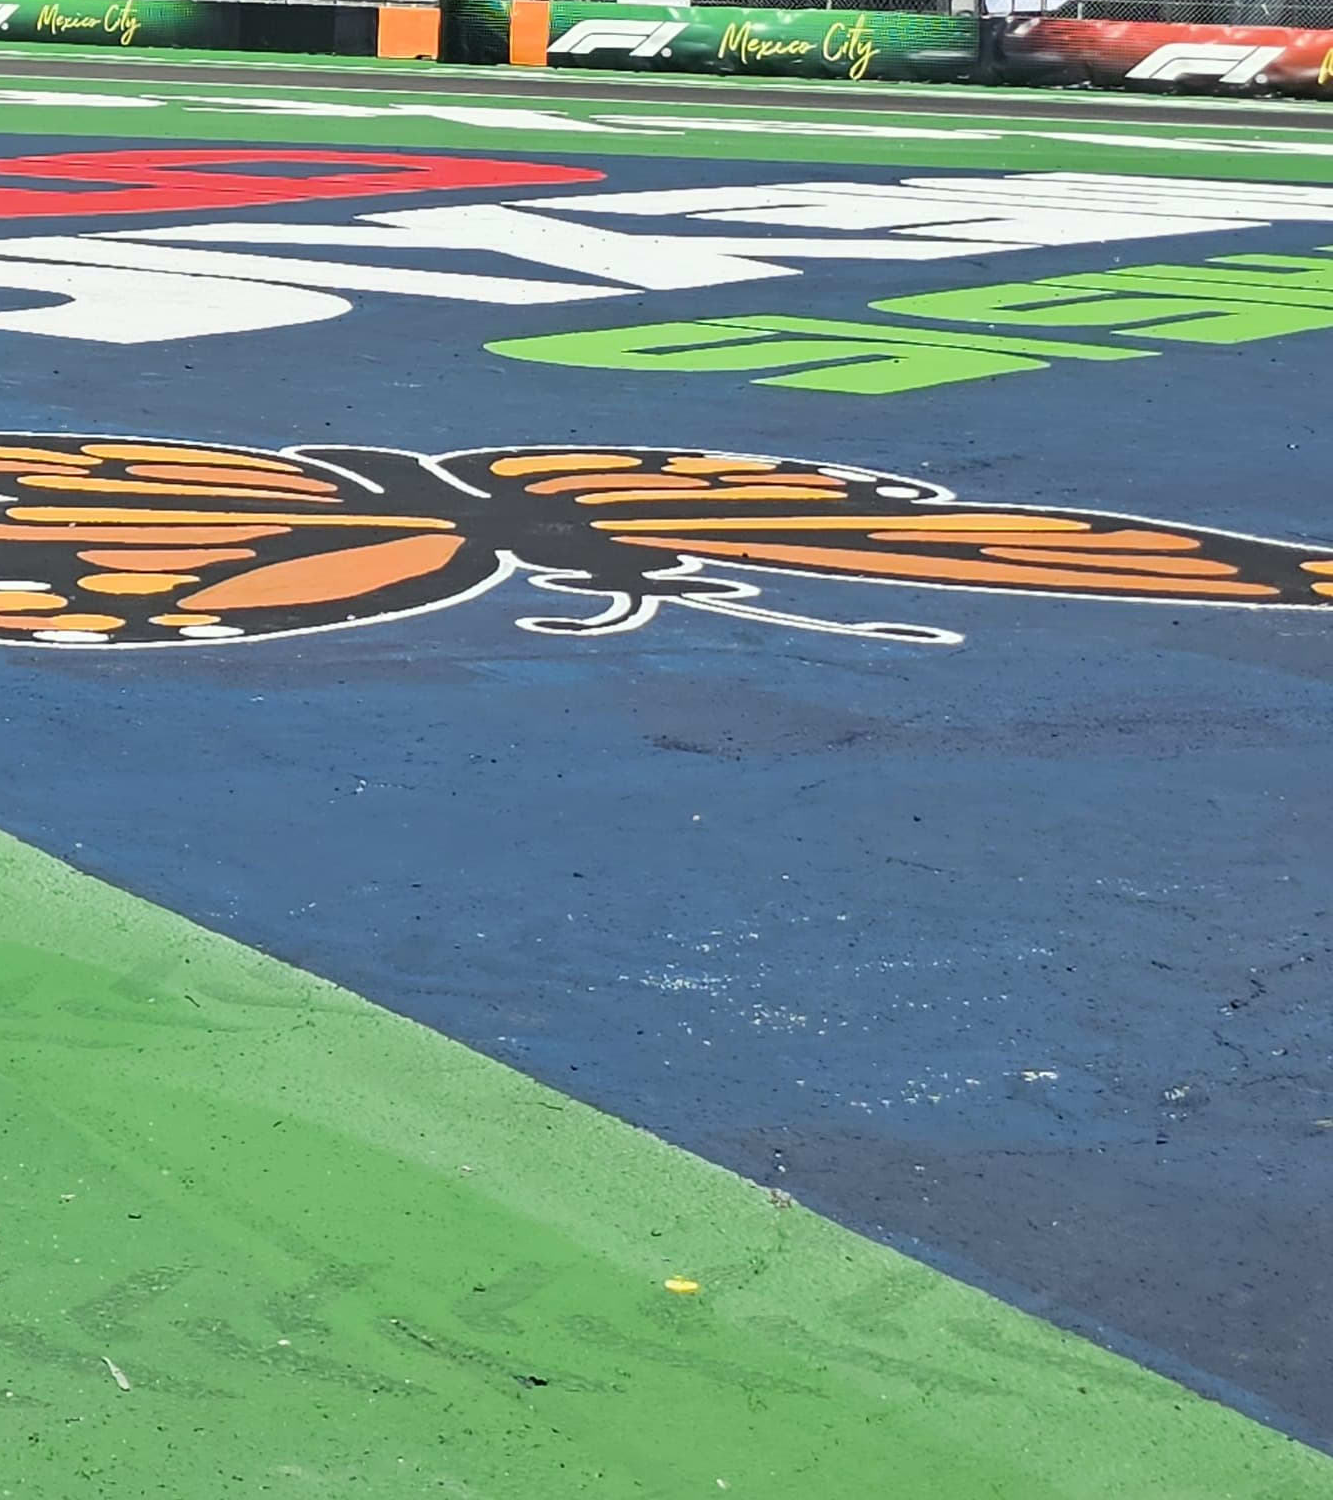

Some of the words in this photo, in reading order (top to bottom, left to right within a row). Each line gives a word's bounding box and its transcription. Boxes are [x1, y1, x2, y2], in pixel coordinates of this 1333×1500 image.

[36, 3, 101, 34] Mexico
[546, 18, 691, 58] F1
[718, 20, 817, 64] Mexico
[823, 13, 880, 80] City
[1124, 42, 1287, 84] F1
